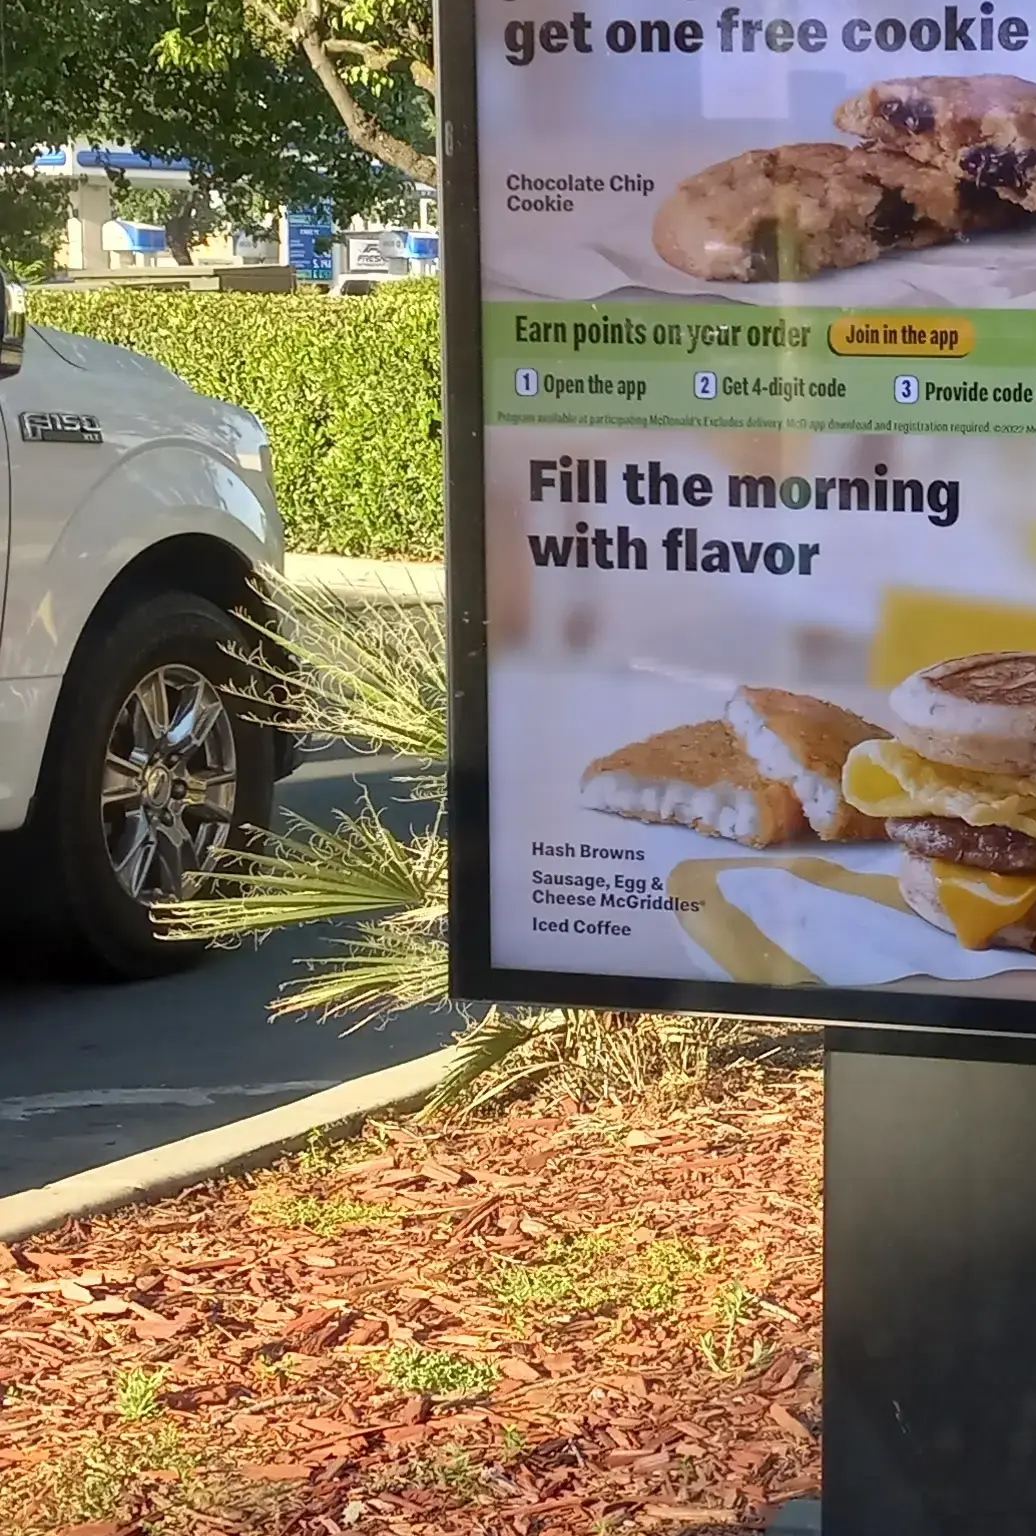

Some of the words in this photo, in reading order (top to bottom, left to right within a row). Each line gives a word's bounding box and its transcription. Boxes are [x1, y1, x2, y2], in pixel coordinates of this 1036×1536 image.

[504, 11, 592, 66] get
[605, 17, 704, 53] one
[716, 7, 827, 53] free
[842, 0, 1029, 52] cookie
[506, 174, 604, 192] Chocolate
[610, 175, 655, 196] Chip
[506, 195, 574, 212] Cookie
[515, 316, 567, 344] Earn
[573, 316, 646, 351] points
[653, 320, 681, 346] on
[687, 322, 742, 354] your
[747, 319, 811, 348] order
[846, 323, 880, 346] Join
[883, 324, 898, 346] in
[901, 324, 926, 345] the
[930, 329, 959, 351] app
[544, 374, 585, 399] Open
[588, 376, 614, 395] the
[617, 380, 647, 401] app
[722, 376, 749, 397] Get
[752, 376, 805, 402] 4-digit
[808, 378, 847, 399] code
[925, 382, 989, 403] Provide
[992, 384, 1034, 404] code
[874, 419, 891, 431] and
[893, 421, 948, 434] registration
[530, 455, 608, 504] Fill
[622, 461, 713, 507] the
[728, 465, 960, 528] morning
[528, 521, 648, 570] with
[662, 527, 819, 576] flavor
[532, 841, 576, 861] Hash
[580, 844, 645, 862] Browns
[532, 870, 610, 891] Sausage,
[615, 874, 647, 893] Egg
[651, 876, 664, 891] &
[533, 889, 597, 907] Cheese
[533, 918, 569, 934] Iced
[573, 920, 632, 937] Coffee
